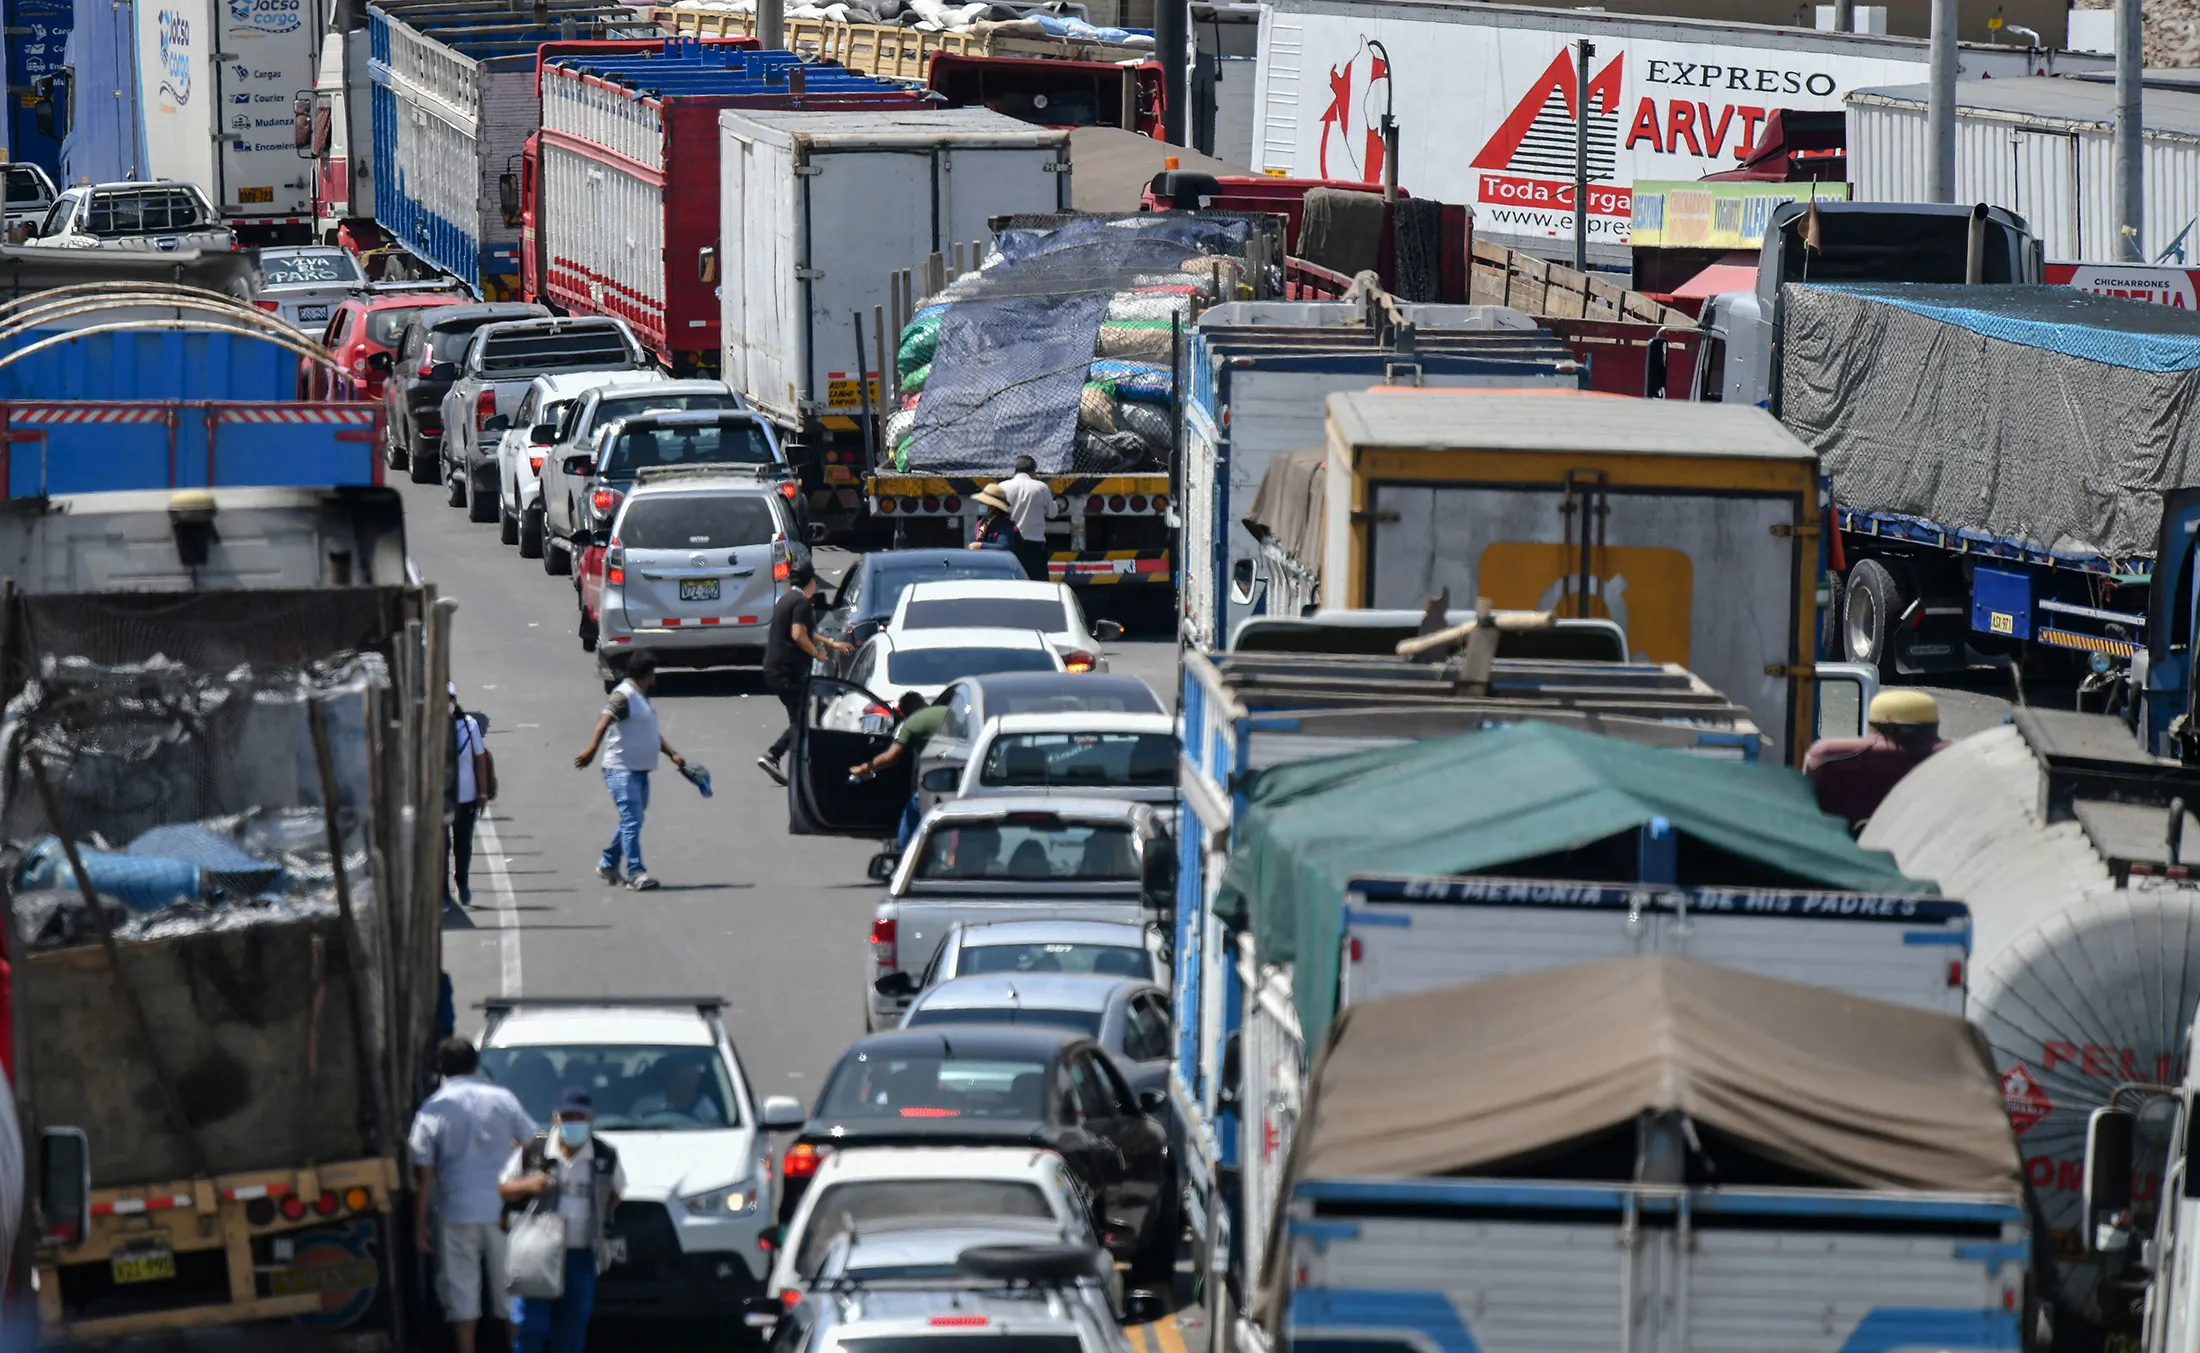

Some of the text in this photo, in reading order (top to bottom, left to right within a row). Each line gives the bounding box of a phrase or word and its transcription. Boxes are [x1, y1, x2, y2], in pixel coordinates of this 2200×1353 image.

[254, 13, 298, 26] cargo
[254, 70, 282, 80] Cargas
[1646, 59, 1836, 97] EXPRESO
[254, 94, 285, 103] Courier
[1483, 177, 1631, 212] Toda Crga
[1491, 209, 1631, 236] www.epres
[2094, 278, 2170, 288] CHICHARRONES
[1461, 881, 1602, 904] MEMORIA
[1802, 892, 1917, 916] PADRES
[2042, 1039, 2184, 1082] PELI
